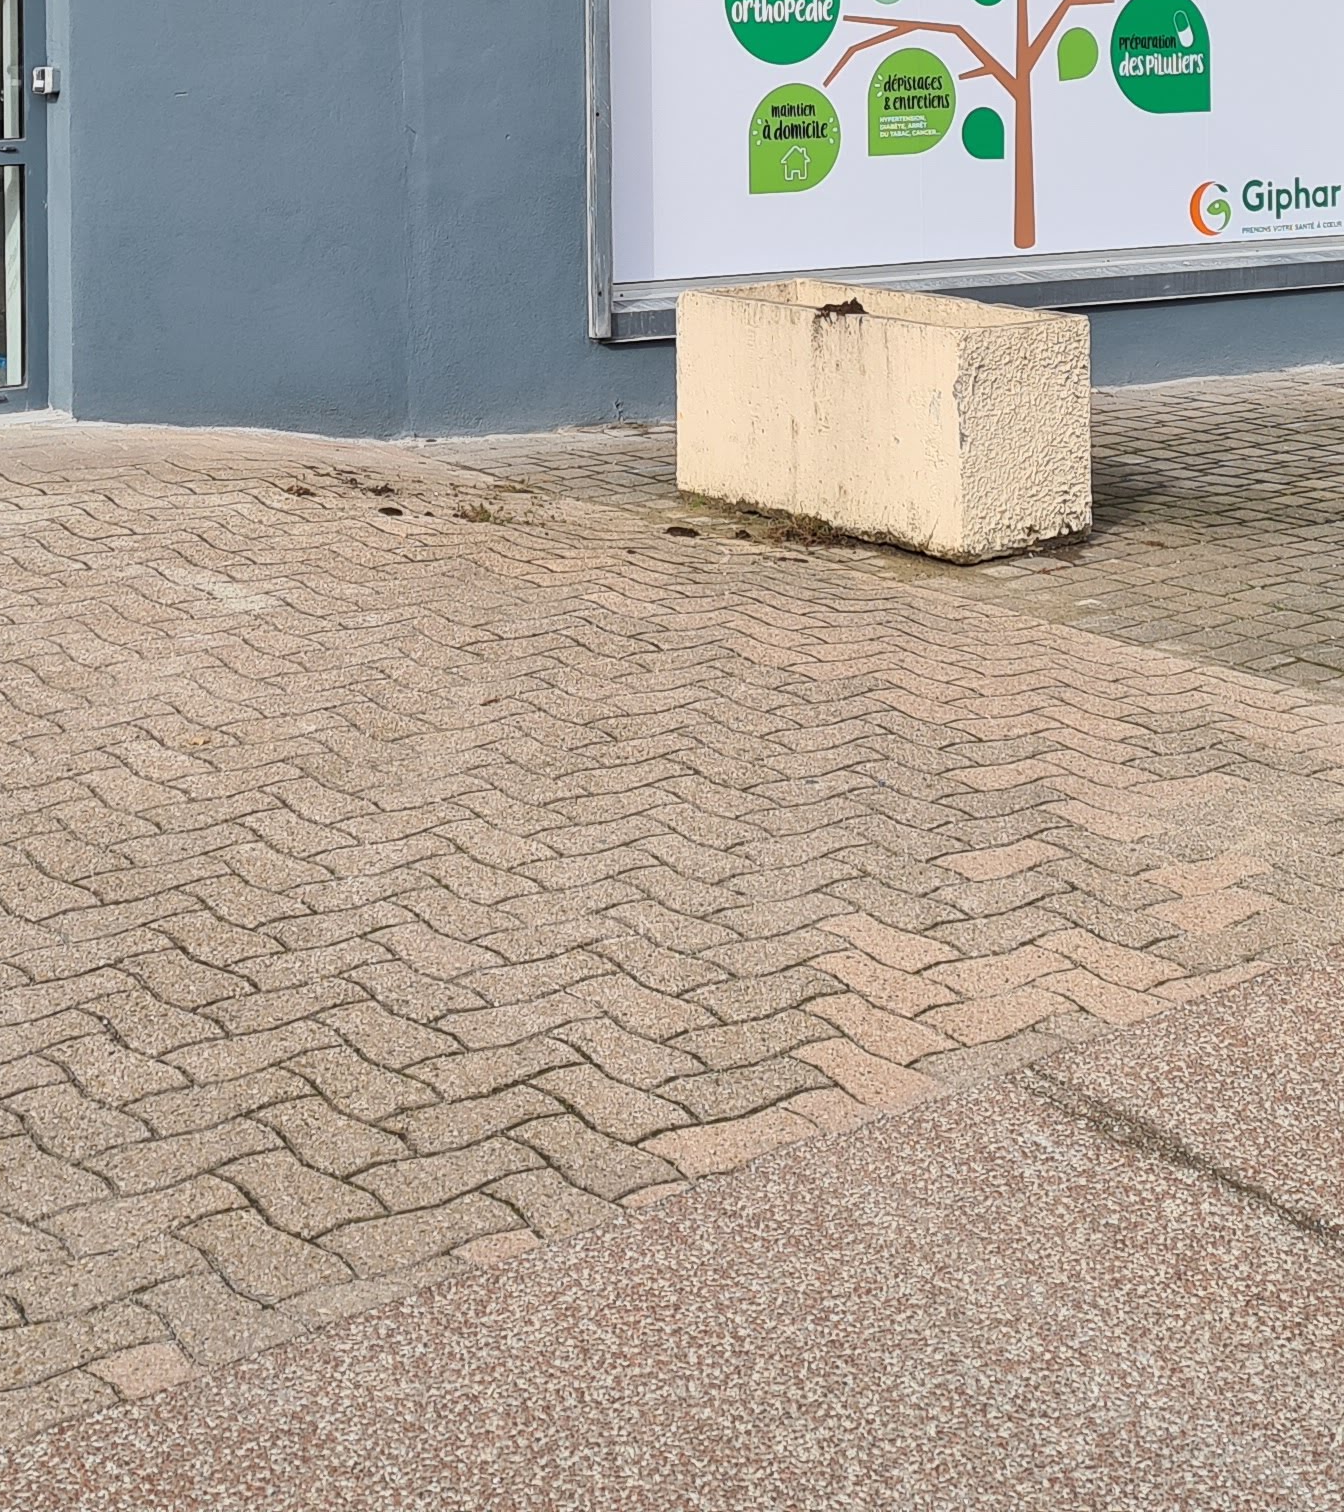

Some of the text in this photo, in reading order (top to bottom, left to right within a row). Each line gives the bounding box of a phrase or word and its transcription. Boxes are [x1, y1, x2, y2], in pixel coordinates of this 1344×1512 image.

[1119, 33, 1176, 51] préparation
[1119, 52, 1144, 76] des
[771, 103, 816, 118] maintien
[884, 93, 950, 110] & entretiens
[762, 119, 828, 141] à domicile
[1242, 177, 1341, 219] Giphar
